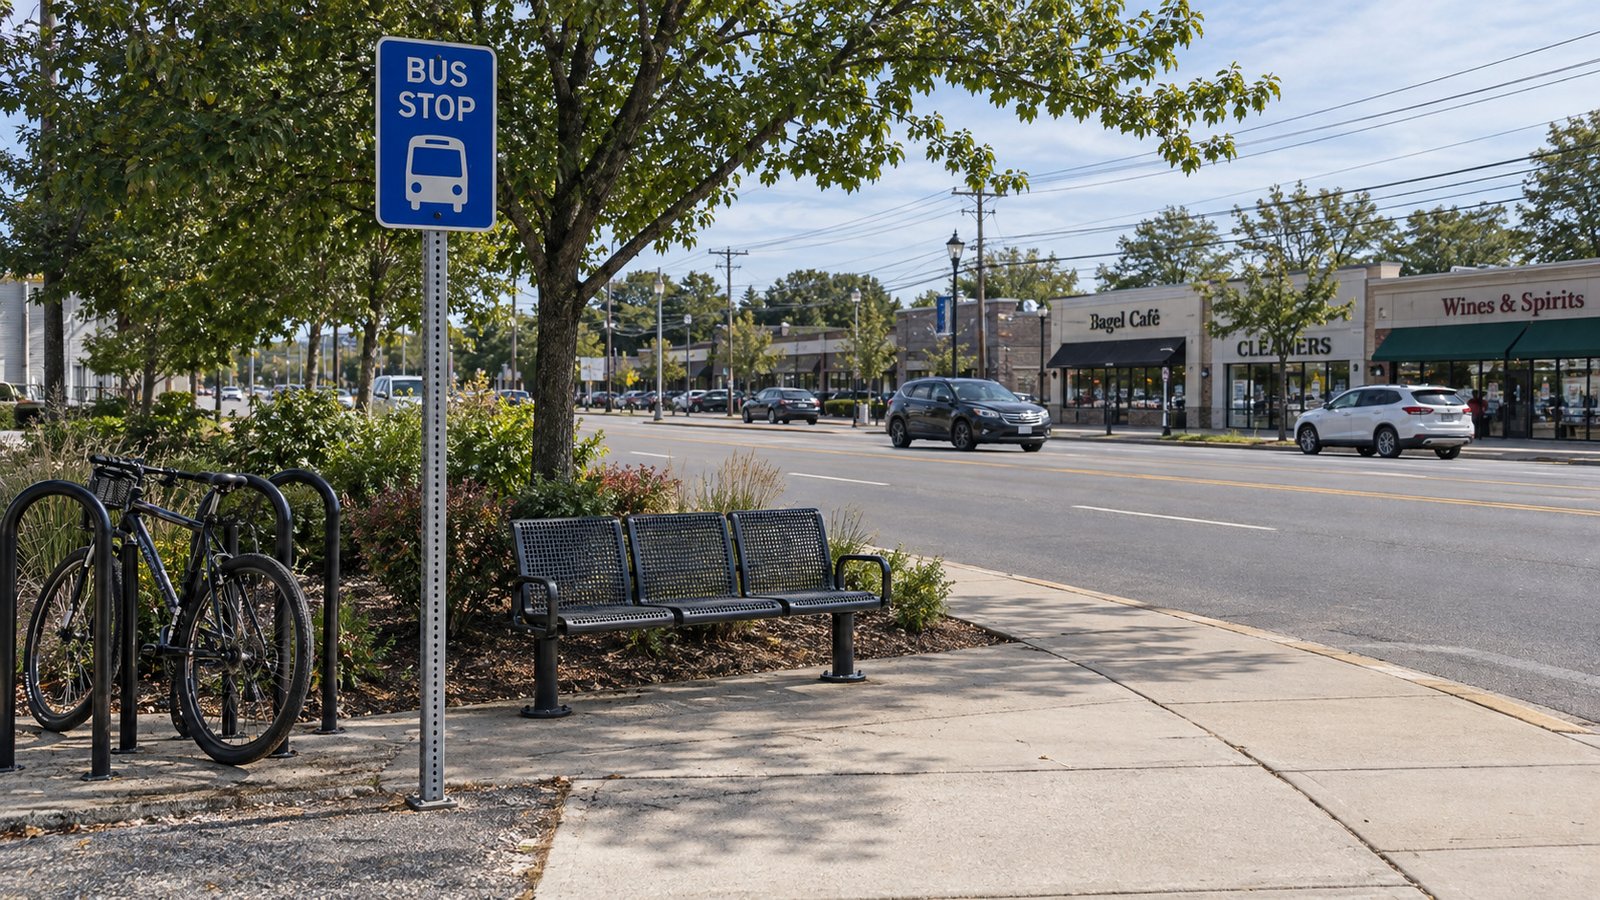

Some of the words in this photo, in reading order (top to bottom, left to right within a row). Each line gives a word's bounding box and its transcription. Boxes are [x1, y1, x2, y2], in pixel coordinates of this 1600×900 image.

[406, 57, 468, 88] BUS
[398, 91, 476, 122] STOP
[1442, 297, 1495, 317] Wines
[1500, 293, 1516, 313] &
[1521, 290, 1584, 317] Spirits
[1090, 311, 1125, 334] Bagel
[1129, 309, 1160, 328] Café
